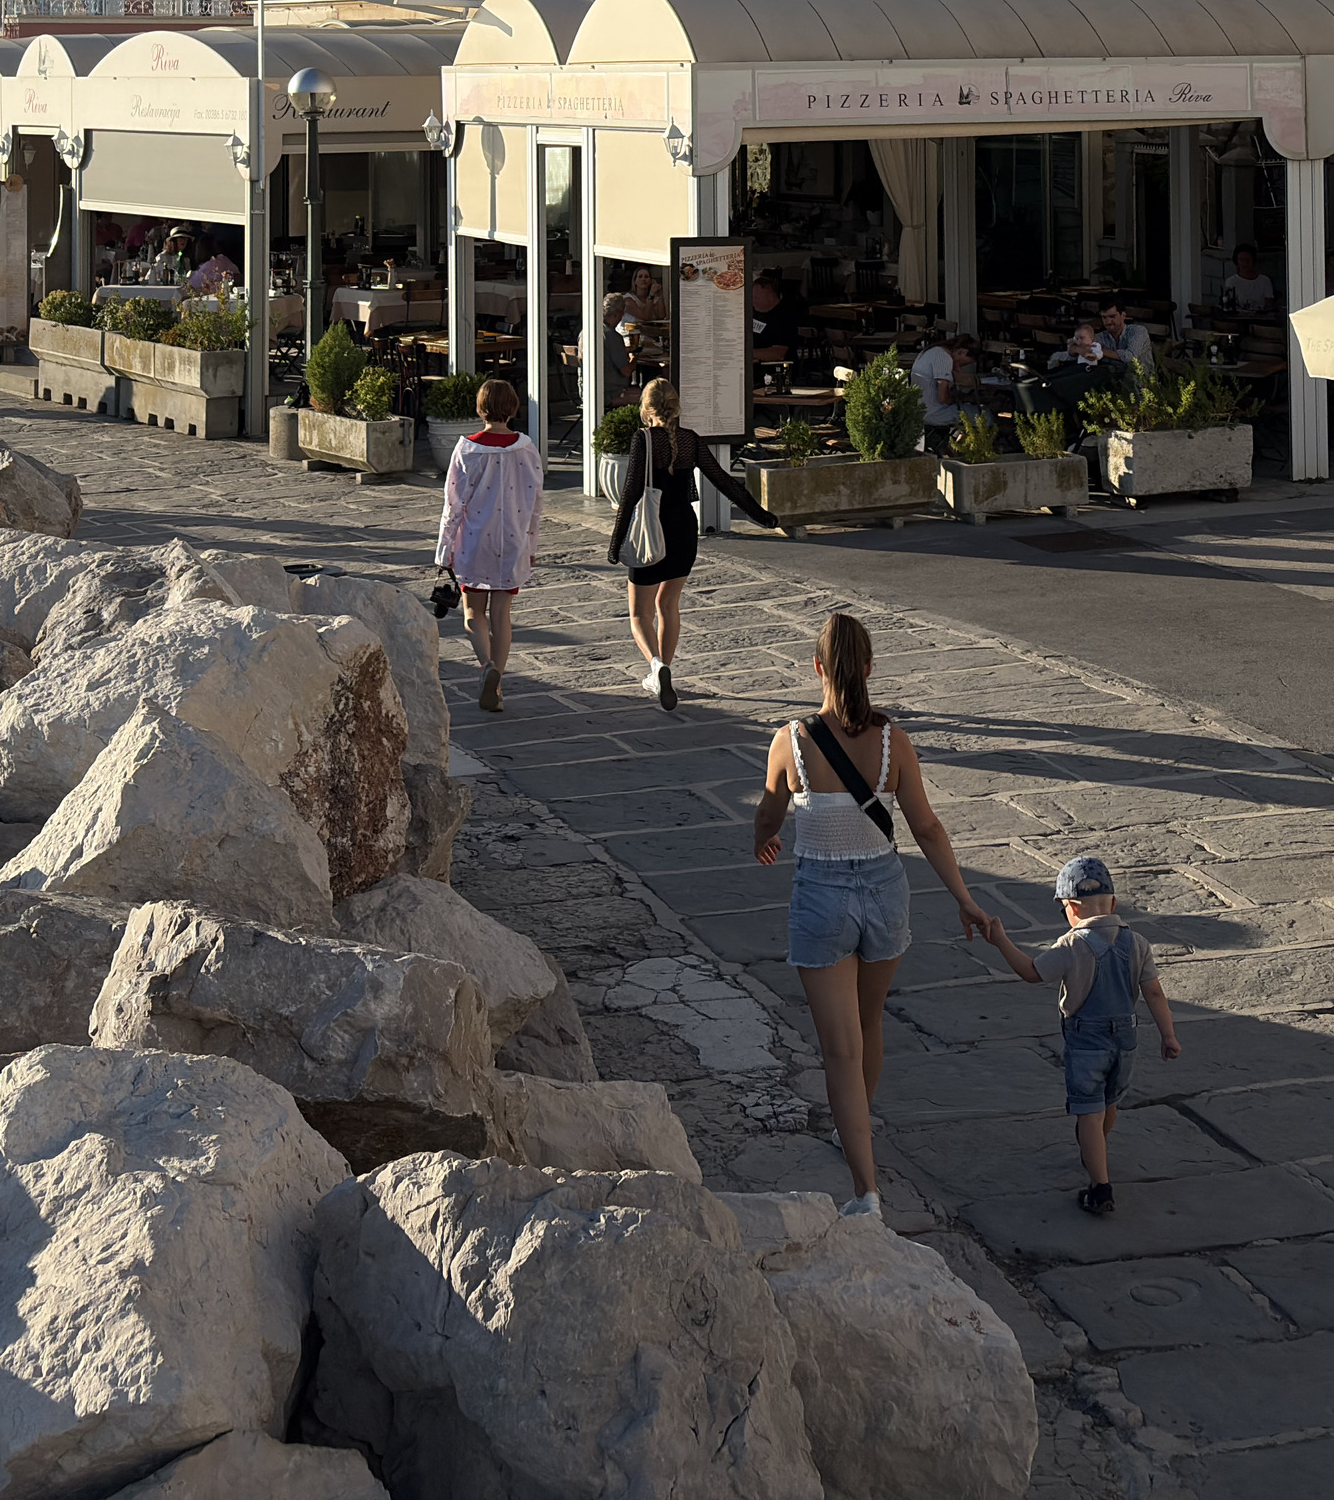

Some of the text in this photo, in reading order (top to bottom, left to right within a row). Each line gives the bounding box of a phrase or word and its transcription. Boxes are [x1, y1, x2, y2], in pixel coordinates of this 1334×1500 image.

[151, 43, 179, 71] Riva
[24, 88, 48, 113] Riva
[497, 95, 624, 112] PIZZERIA SPAGHETTERIA
[807, 82, 1213, 109] PIZZERIA SPAGHETTERIA Riva
